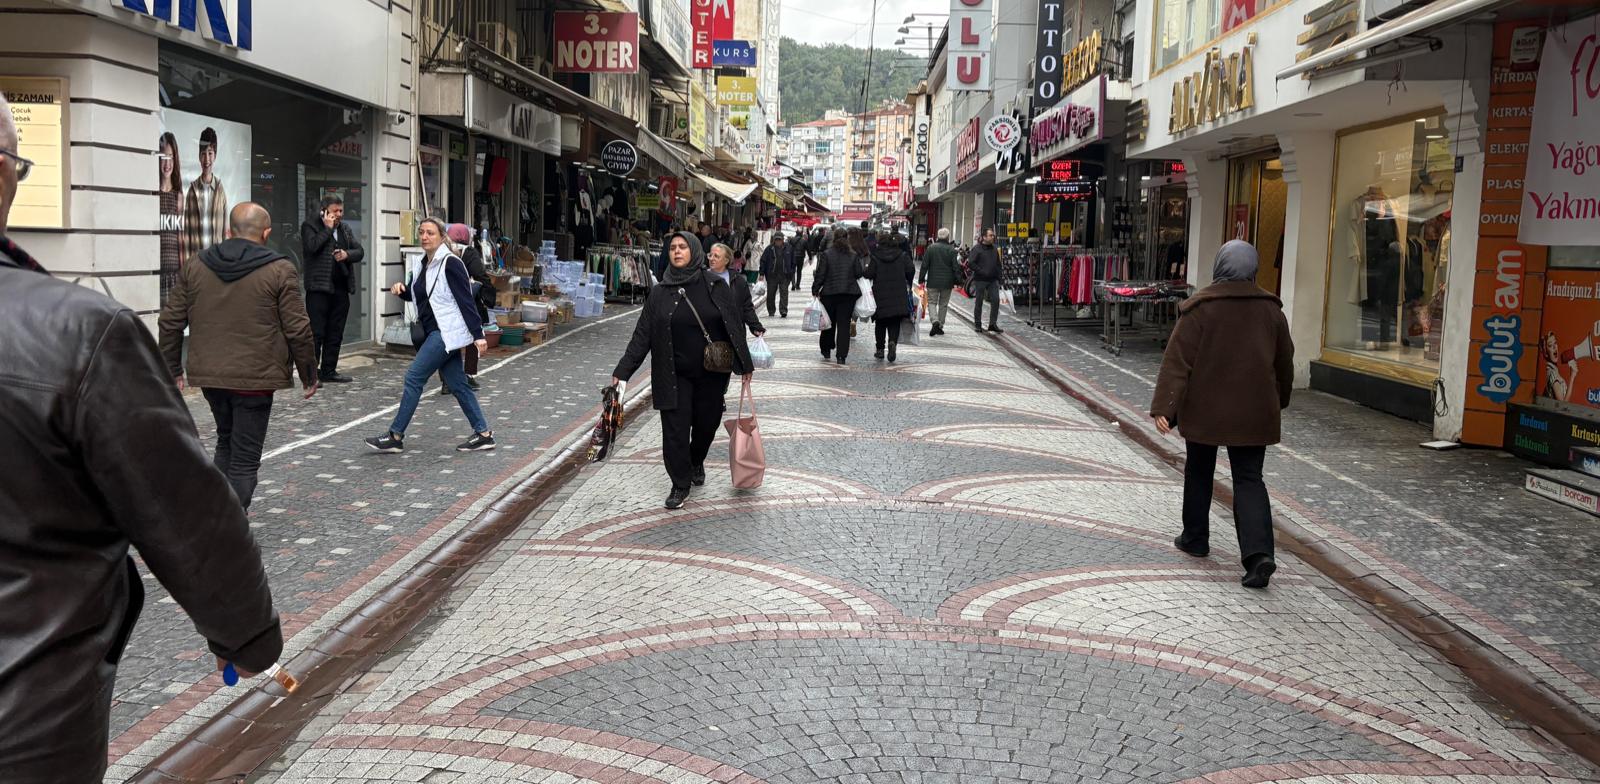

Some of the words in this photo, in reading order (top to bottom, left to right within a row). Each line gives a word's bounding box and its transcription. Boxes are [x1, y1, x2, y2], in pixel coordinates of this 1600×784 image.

[584, 14, 608, 35] 3.
[557, 40, 633, 69] NOTER
[713, 48, 749, 58] KURS
[732, 80, 741, 90] 3.
[719, 91, 753, 102] NOTER
[608, 146, 631, 155] PAZAR
[916, 123, 929, 174] DeFacto
[1495, 250, 1523, 310] avm
[1481, 318, 1517, 393] bulut
[1564, 487, 1592, 505] borcam
